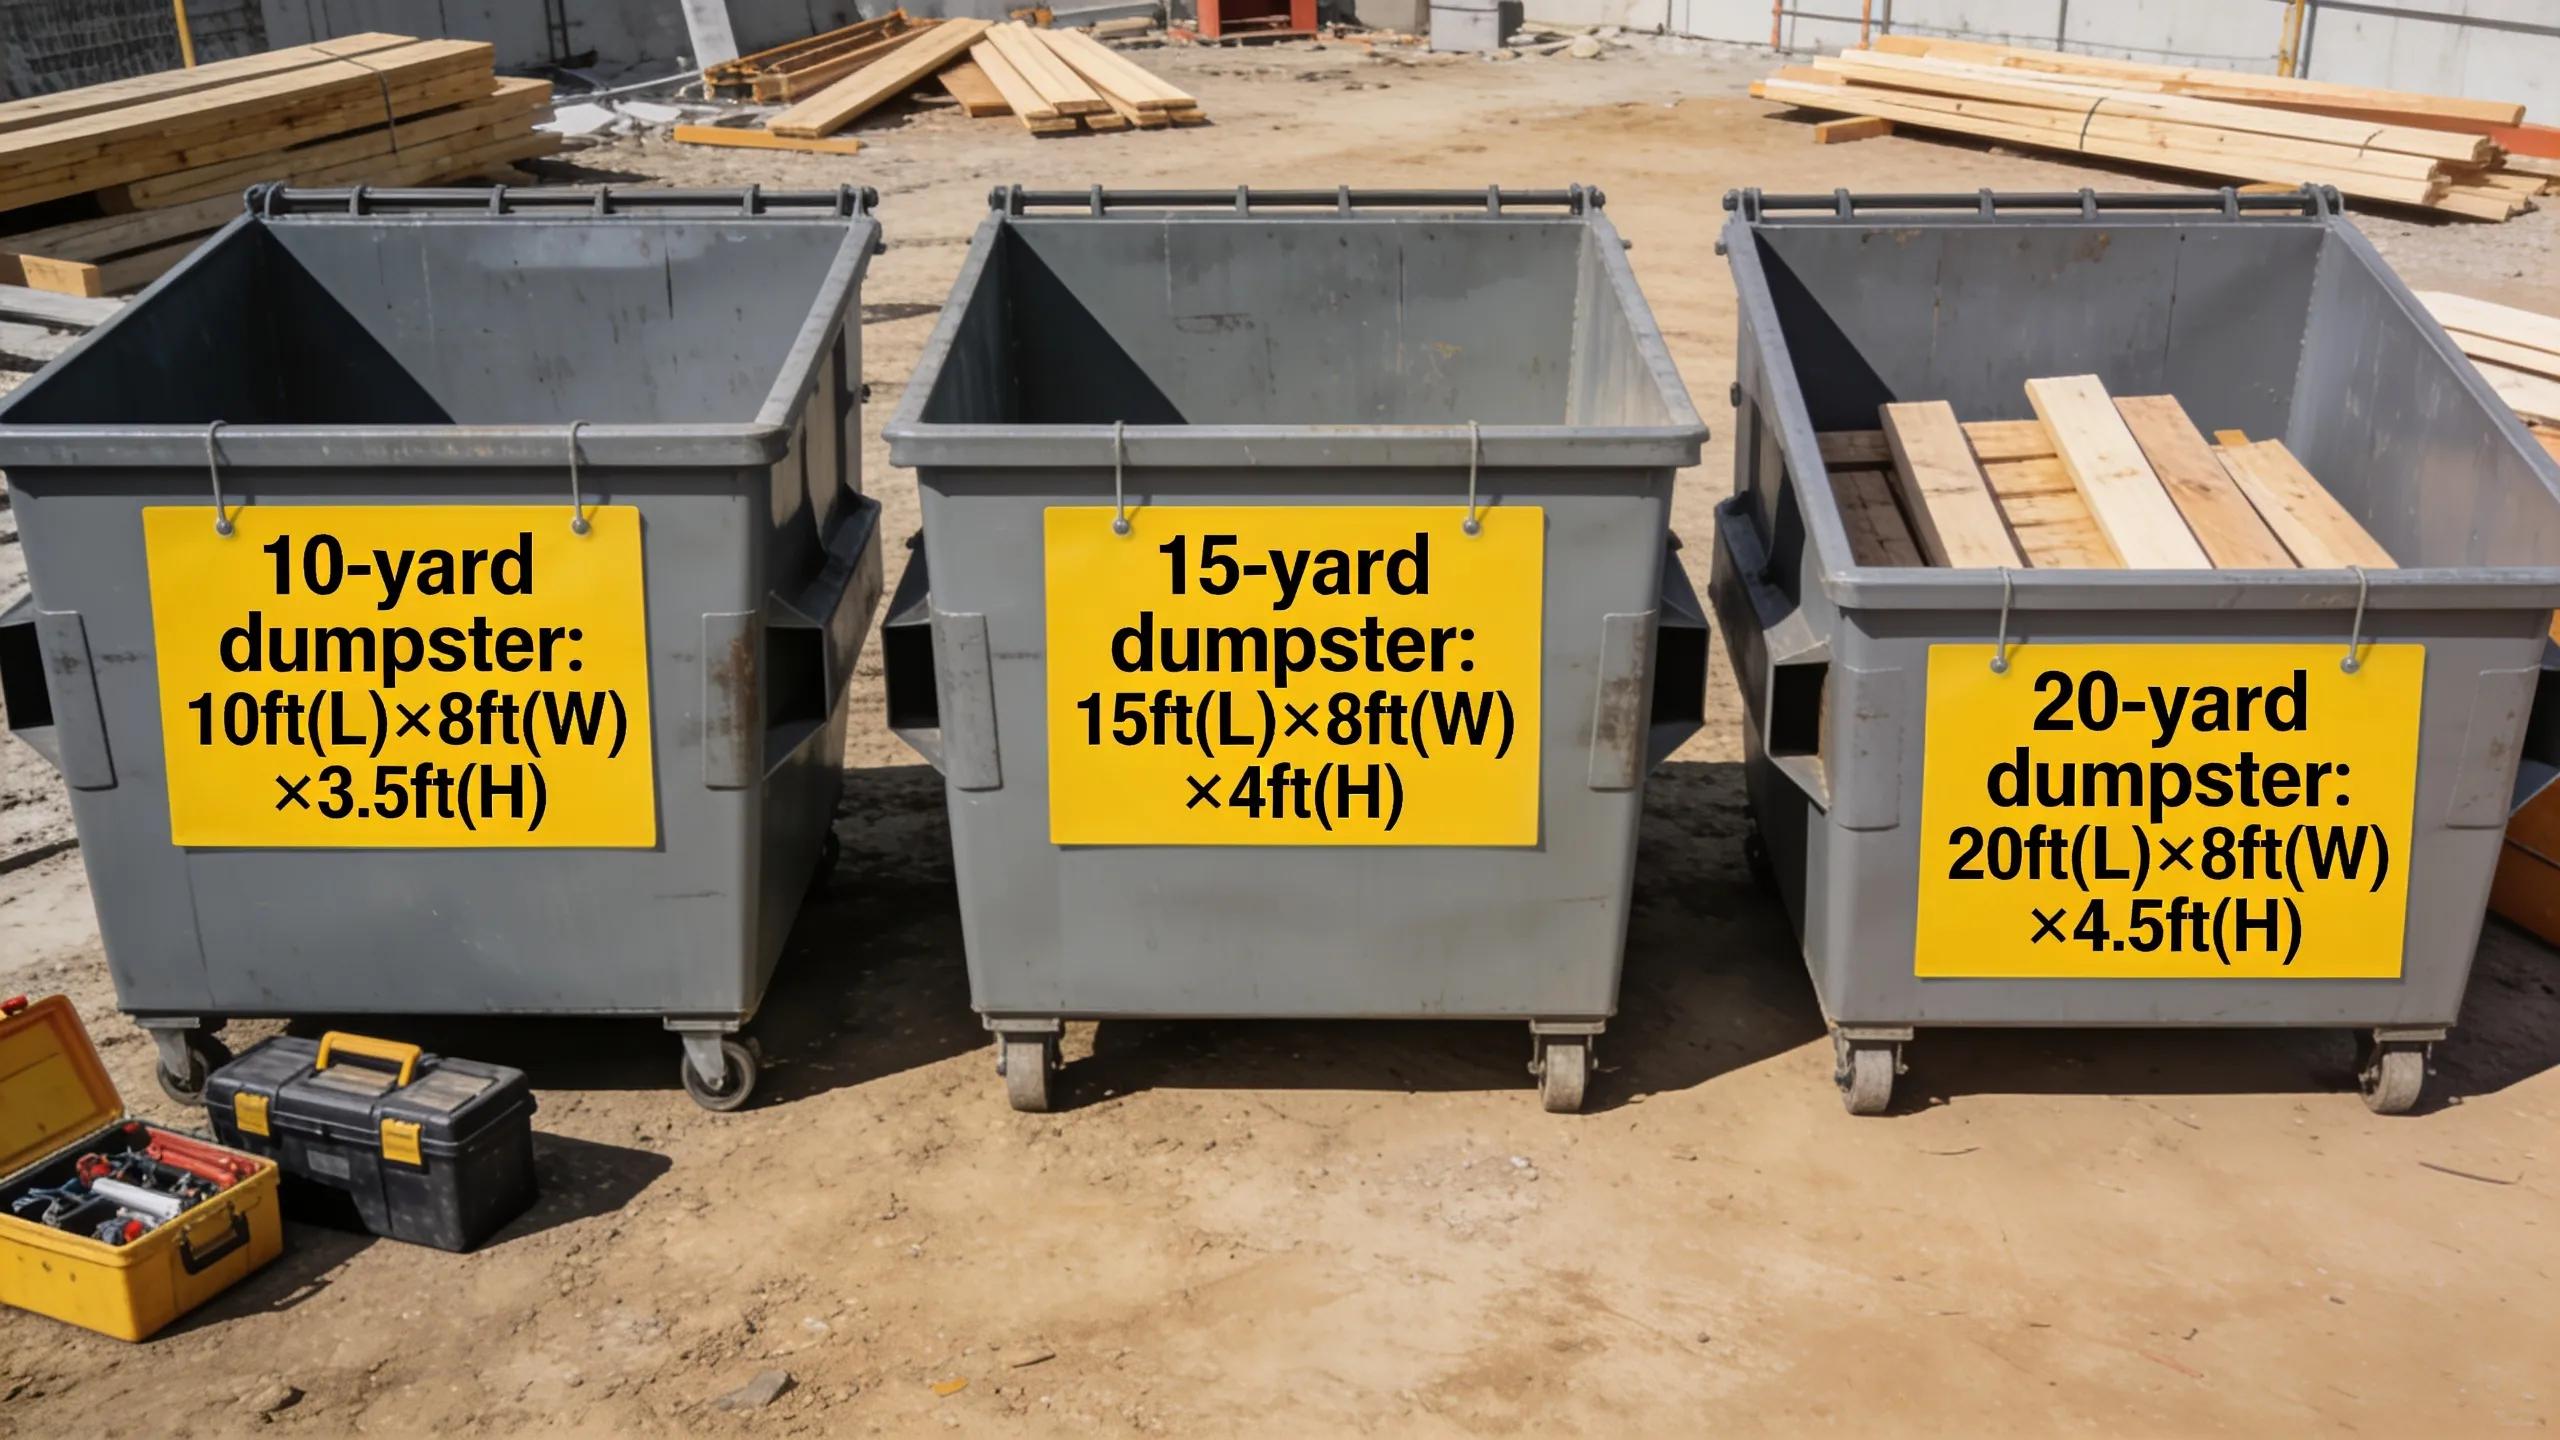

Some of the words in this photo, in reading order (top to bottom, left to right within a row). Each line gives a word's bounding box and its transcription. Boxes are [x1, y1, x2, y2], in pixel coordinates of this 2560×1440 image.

[263, 531, 534, 611] 10-yard
[1159, 531, 1430, 611] 15-yard
[219, 610, 584, 689] dumpster:
[1111, 611, 1475, 689] dumpster:
[188, 690, 627, 759] 10ft(L)×8ft(W)
[1077, 690, 1515, 760] 15ft(L)×8ft(W)
[2033, 669, 2307, 749] 20-yard
[275, 762, 547, 832] ×3.5ft(H)
[1186, 762, 1404, 832] ×4ft(H)
[1987, 746, 2351, 825] dumpster:
[1948, 824, 2389, 893] 20ft(L)×8ft(W)
[2031, 896, 2302, 966] ×4.5ft(H)
